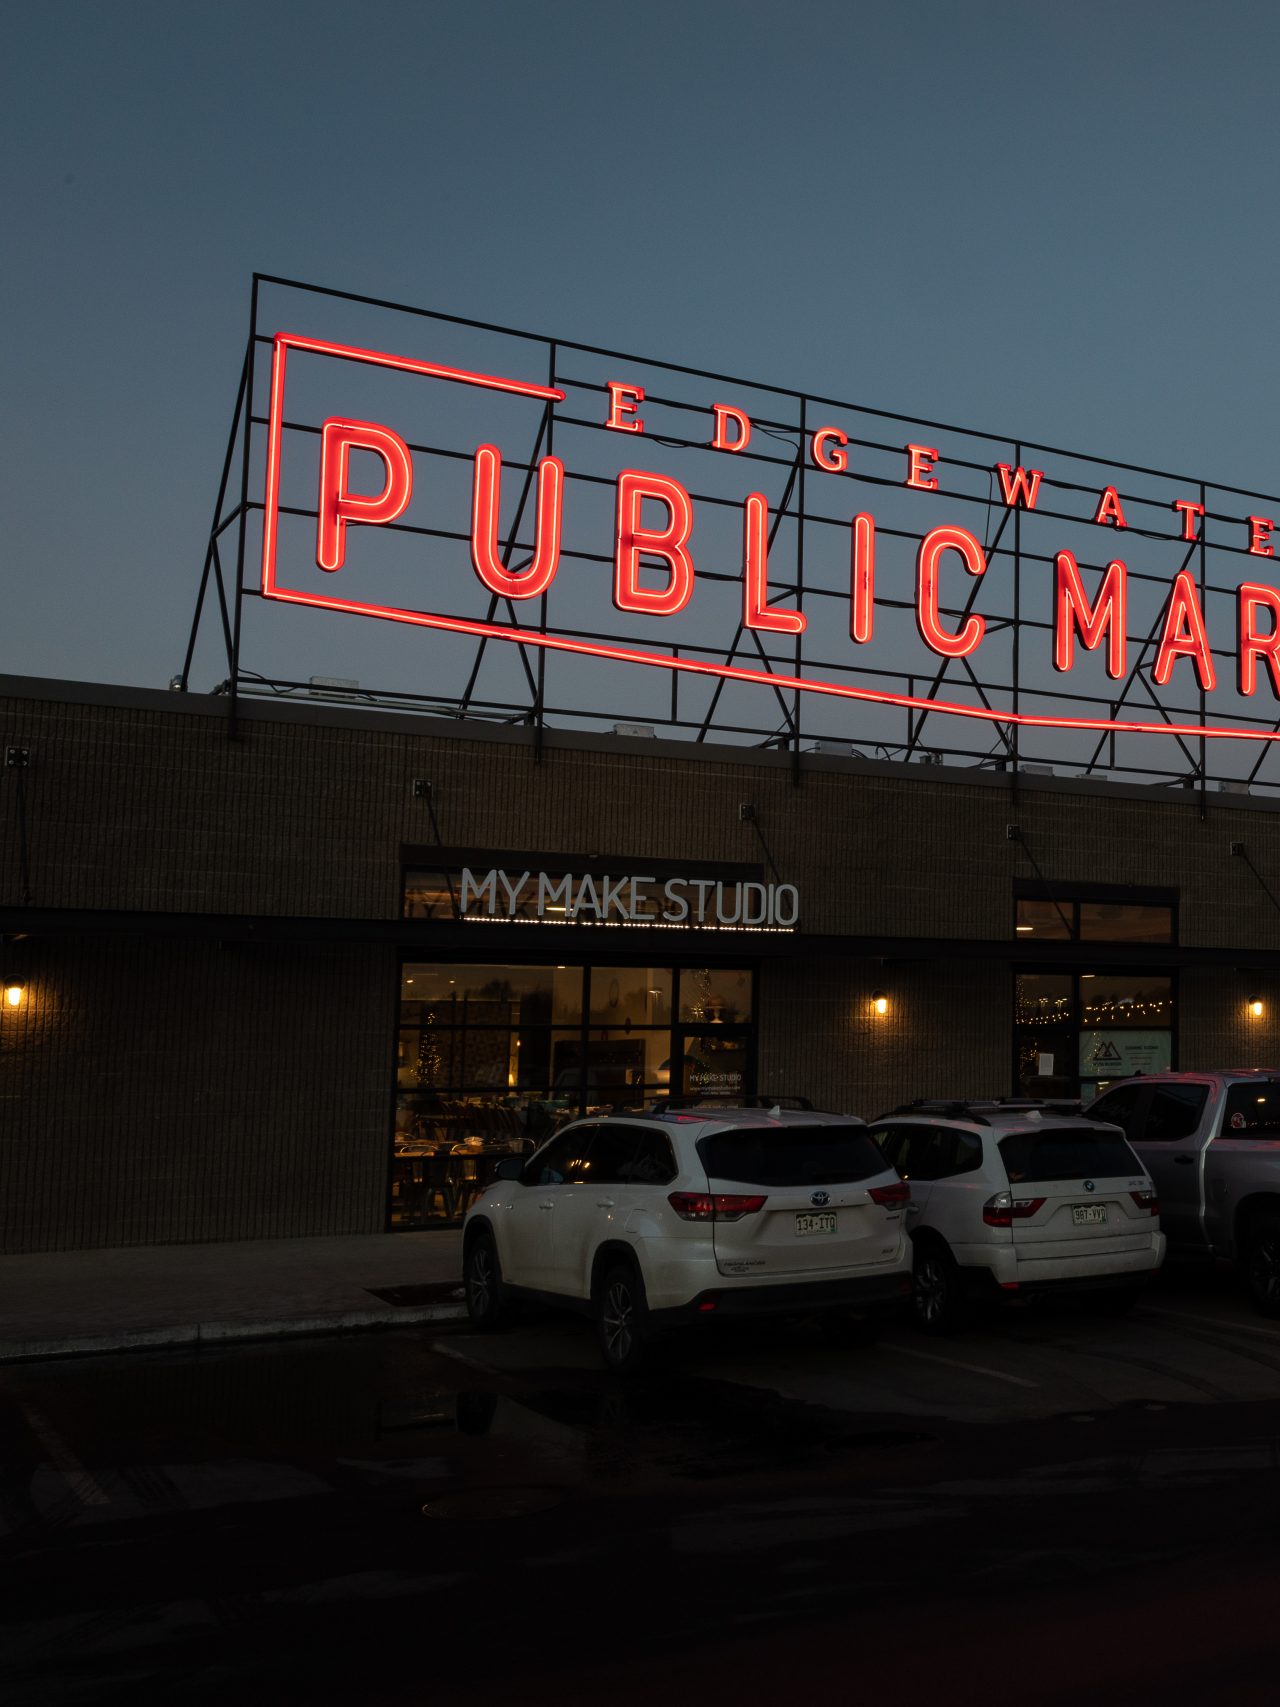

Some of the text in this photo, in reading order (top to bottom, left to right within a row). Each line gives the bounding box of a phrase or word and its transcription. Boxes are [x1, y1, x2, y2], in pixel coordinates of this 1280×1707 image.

[316, 416, 987, 658] PUBLIC
[460, 867, 530, 915] MY
[537, 871, 656, 920] MAKE
[662, 878, 799, 926] STUDIO
